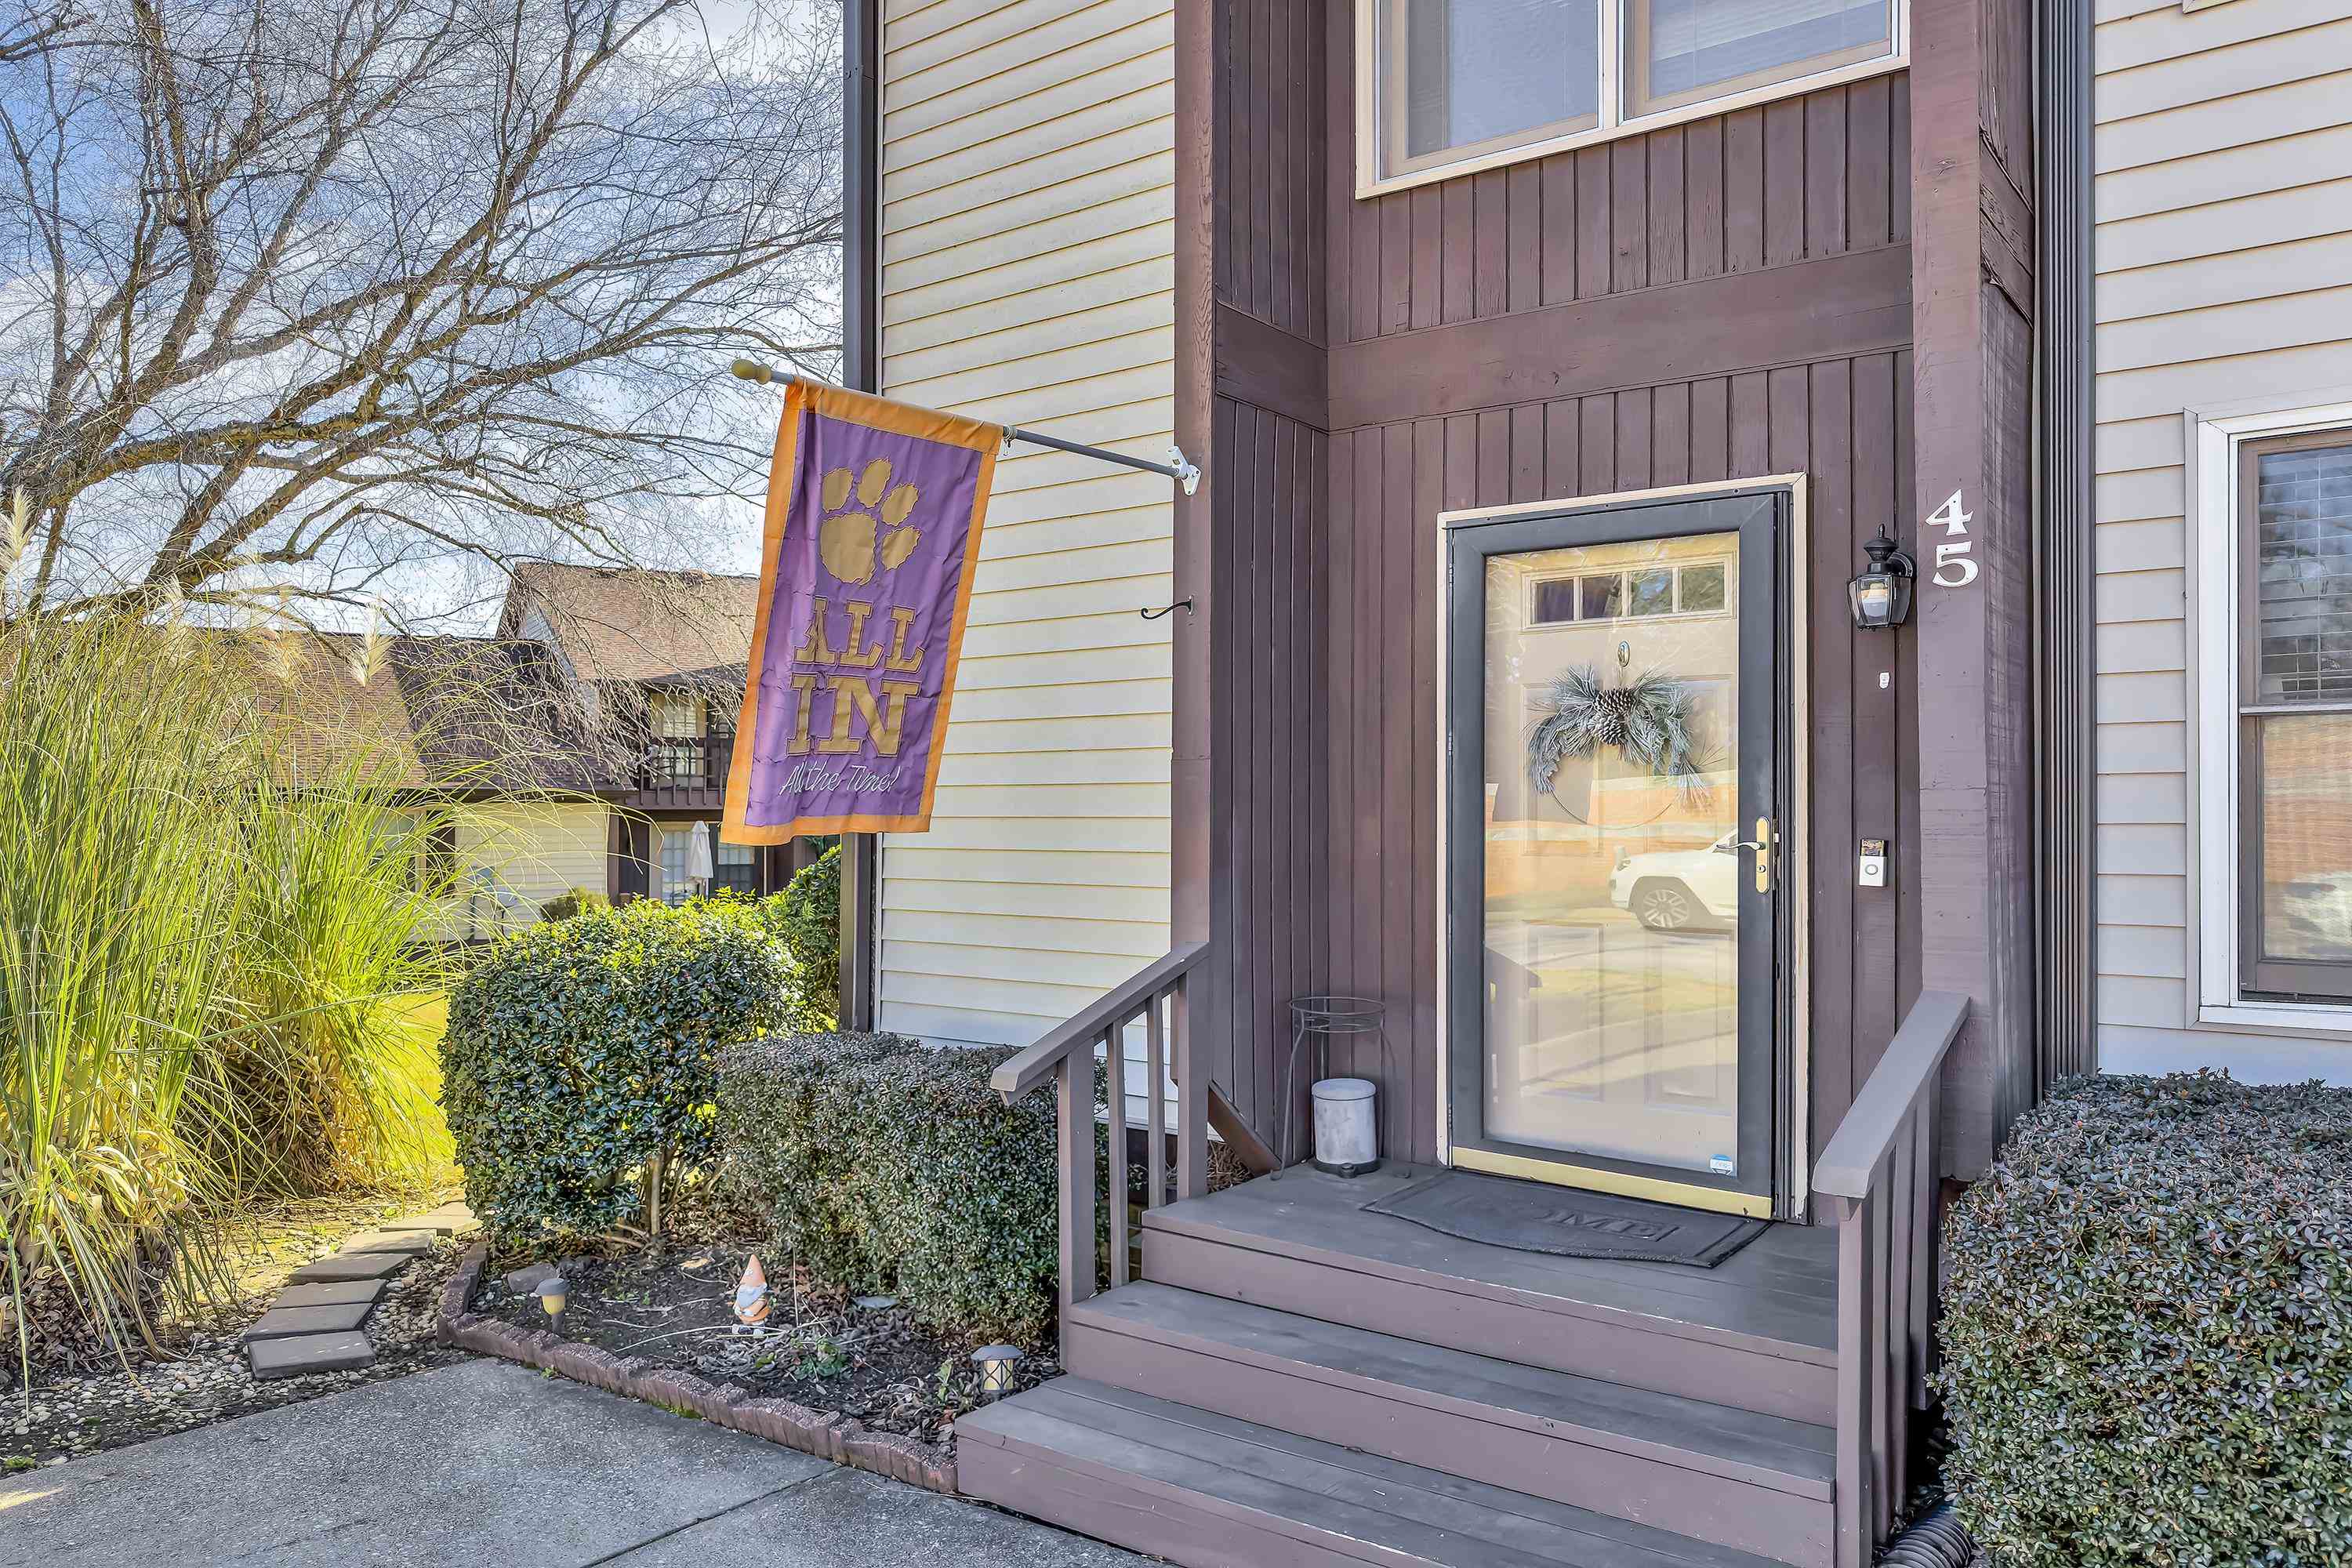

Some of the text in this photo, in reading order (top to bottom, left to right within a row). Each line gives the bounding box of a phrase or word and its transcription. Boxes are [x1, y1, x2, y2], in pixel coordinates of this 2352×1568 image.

[1925, 488, 1980, 587] 45
[793, 595, 926, 674] ALL
[786, 672, 923, 758] IN
[779, 760, 807, 796] All
[804, 759, 842, 792] the
